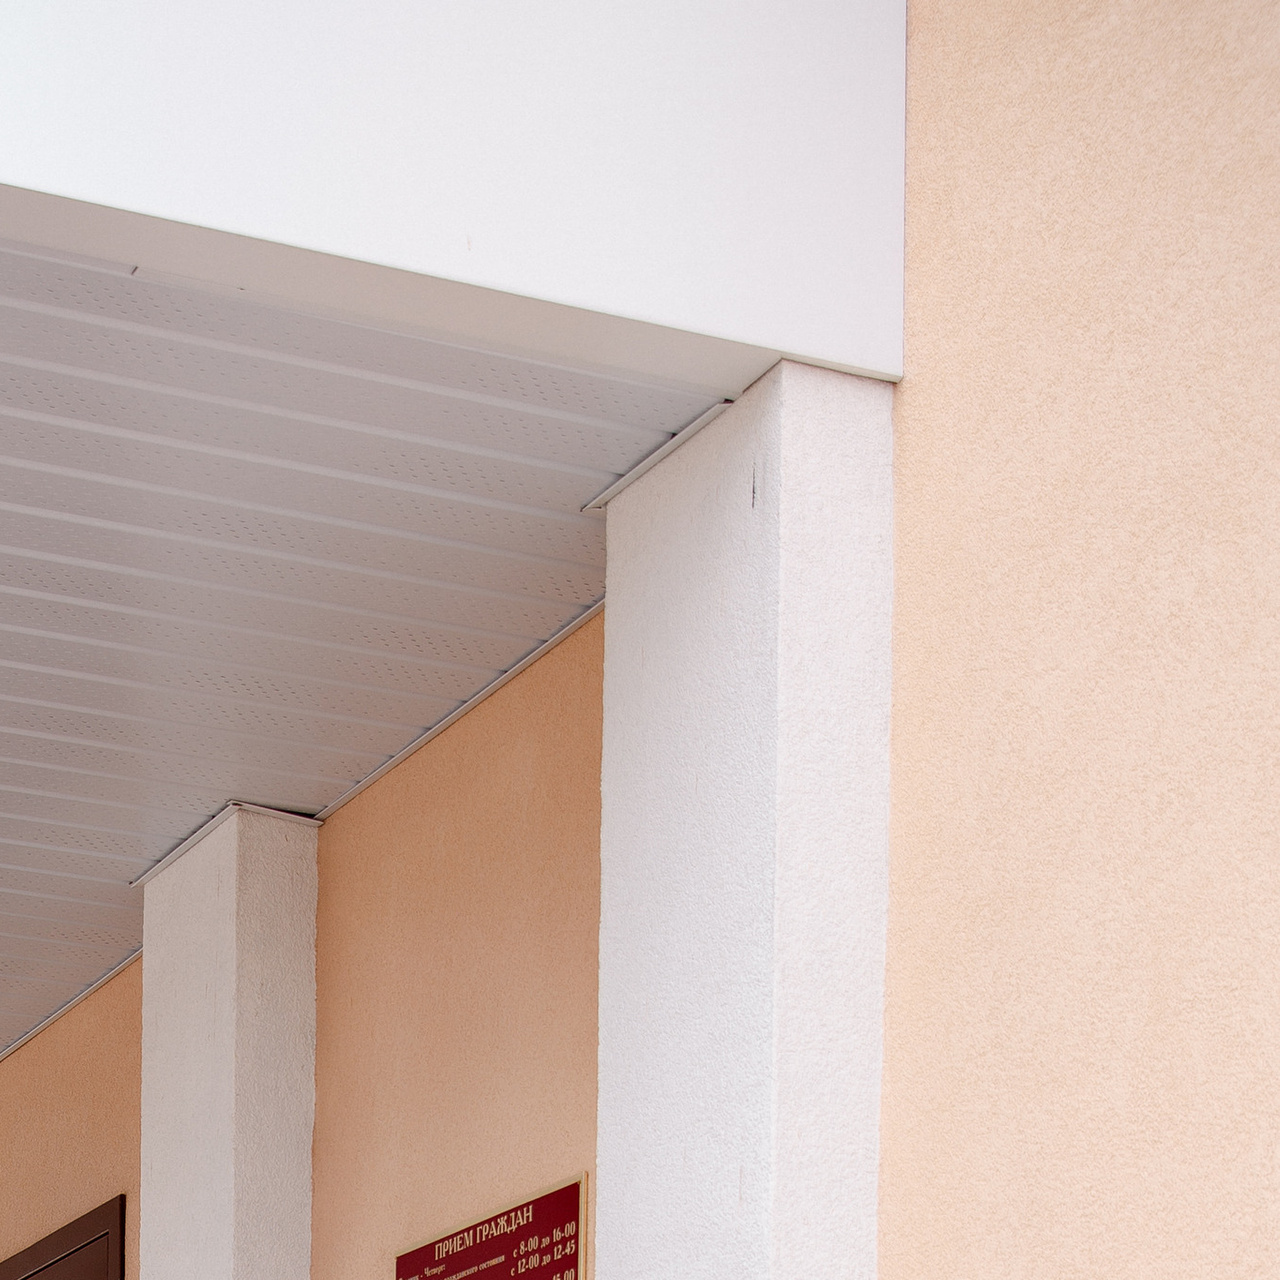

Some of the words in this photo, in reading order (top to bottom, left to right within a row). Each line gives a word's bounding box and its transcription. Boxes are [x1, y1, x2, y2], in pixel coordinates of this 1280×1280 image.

[435, 1230, 473, 1260] ПРИЕМ
[476, 1205, 533, 1243] ГРАЖДАН
[479, 1255, 505, 1270] состояния
[541, 1237, 550, 1248] до
[511, 1268, 515, 1276] с
[541, 1255, 550, 1266] до
